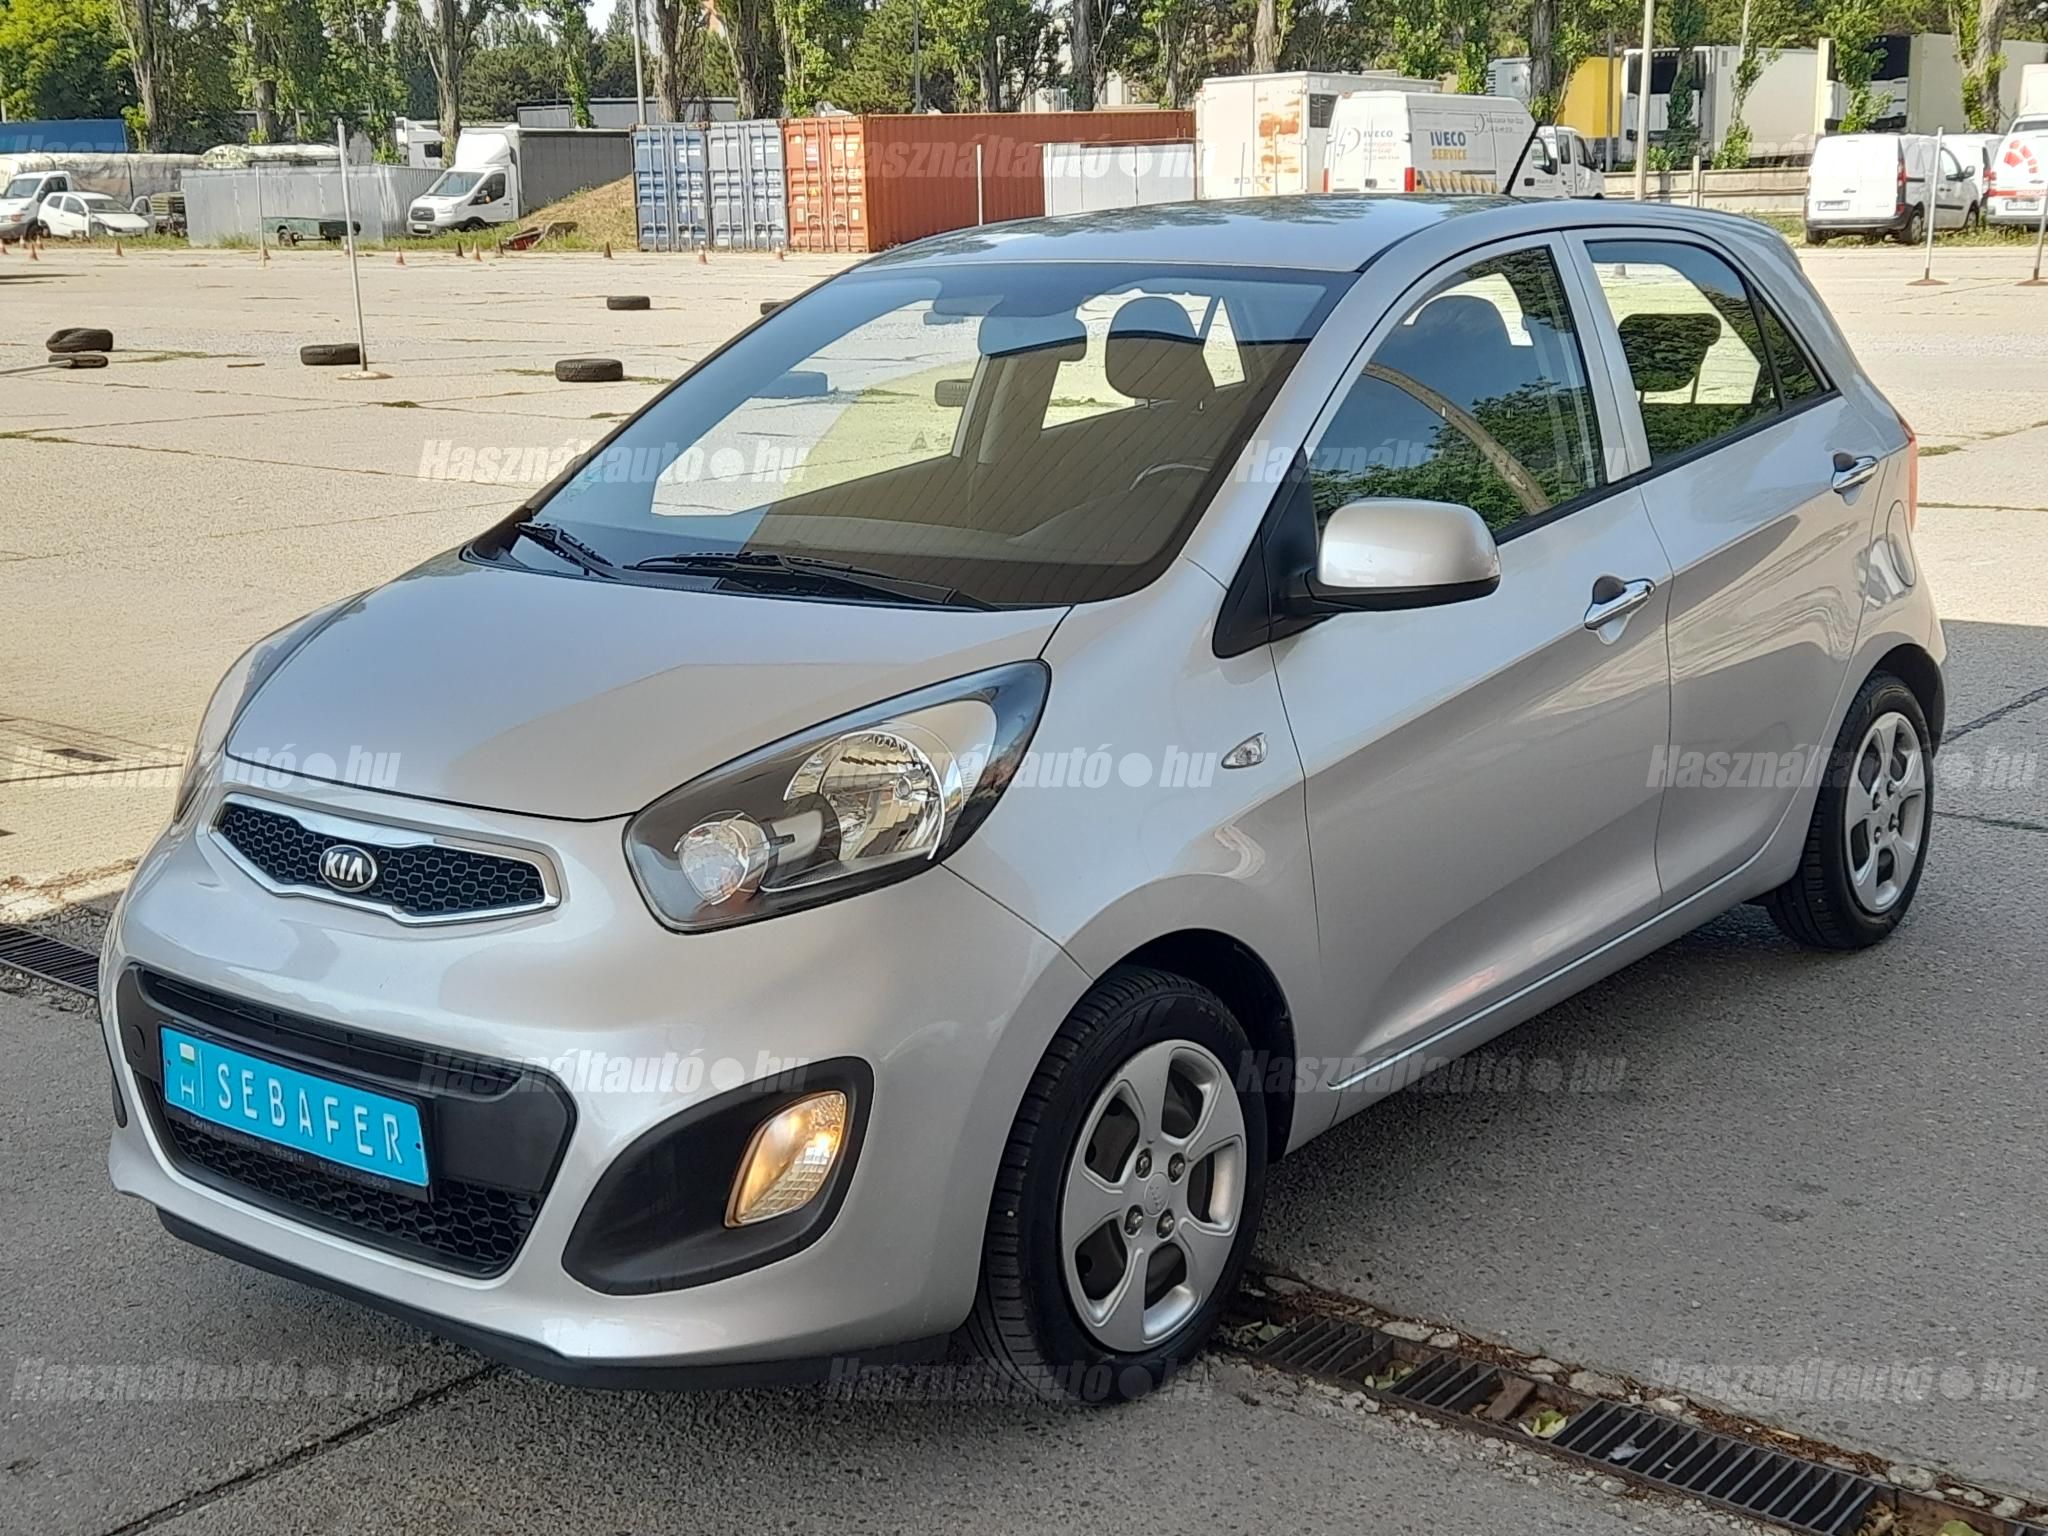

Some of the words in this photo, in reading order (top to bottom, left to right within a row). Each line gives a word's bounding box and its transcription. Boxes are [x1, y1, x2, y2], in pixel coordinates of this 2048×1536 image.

[1430, 131, 1466, 146] IVECO
[1431, 148, 1467, 160] SERVICE
[325, 851, 364, 884] KIA
[180, 1076, 195, 1106] H
[217, 1062, 403, 1165] SEBAFER
